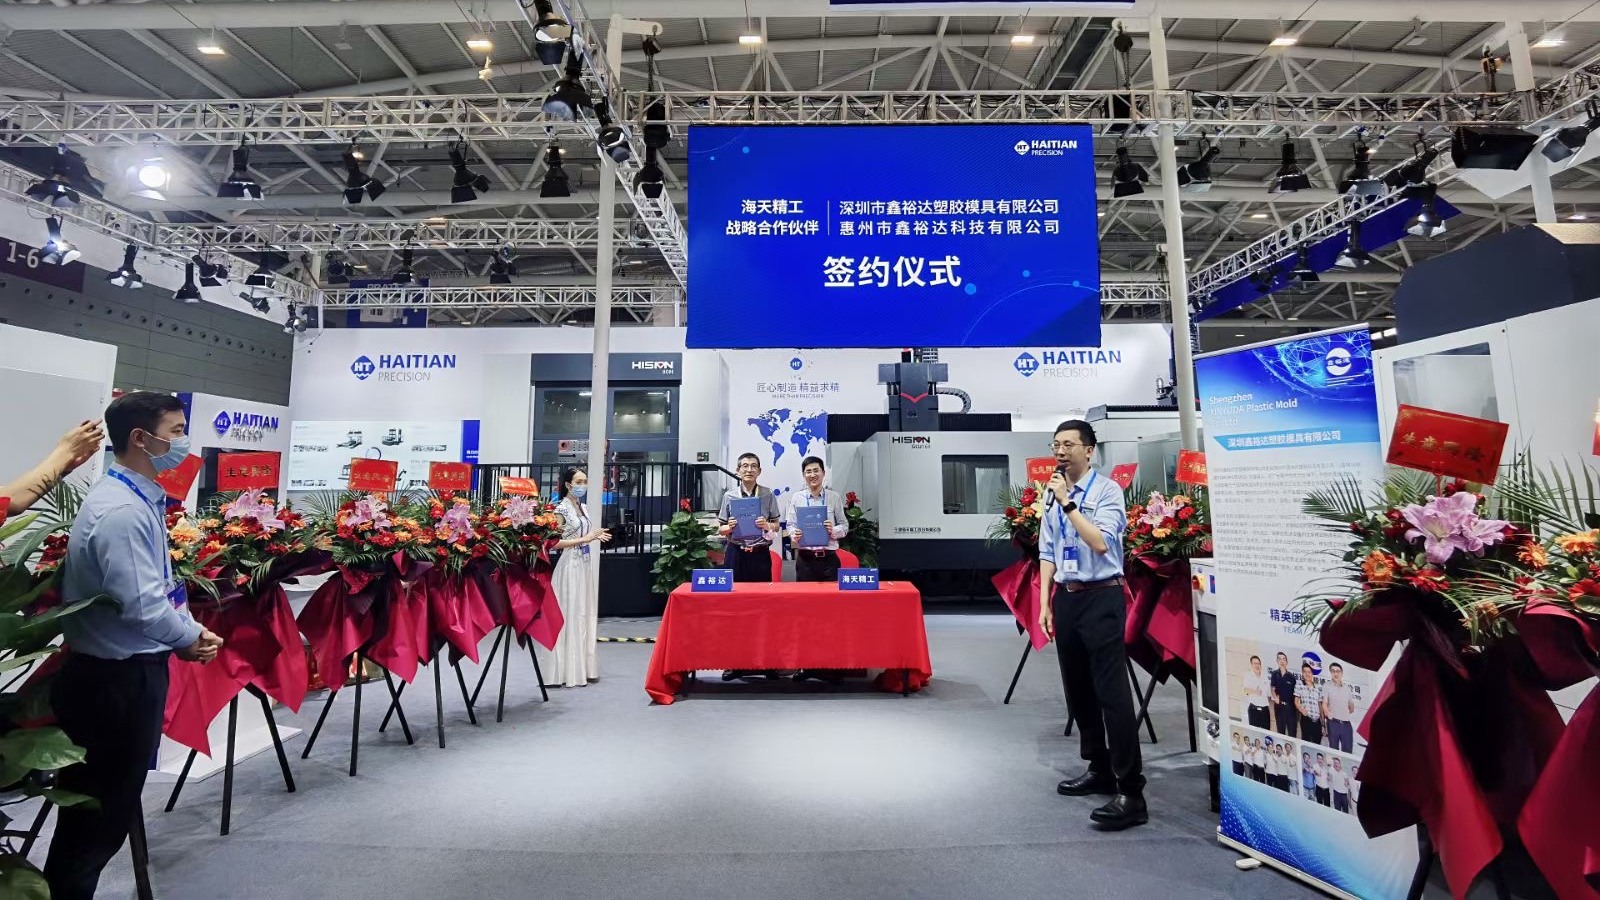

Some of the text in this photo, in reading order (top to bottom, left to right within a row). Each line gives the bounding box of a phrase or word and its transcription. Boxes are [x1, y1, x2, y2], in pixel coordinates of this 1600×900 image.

[1031, 140, 1077, 149] HAITIAN
[741, 199, 804, 214] 海天精工
[839, 200, 1059, 216] 深圳市鑫裕达塑胶模具有限公司
[725, 220, 819, 236] 战略合作伙伴
[839, 220, 1060, 236] 惠州市鑫裕达科技有限公司
[7, 242, 40, 269] 1-6
[823, 255, 962, 288] 签约仪式
[379, 354, 456, 369] HAITIAN
[1042, 350, 1121, 365] HAITIAN
[378, 371, 431, 382] PRECISION
[1043, 367, 1098, 378] PRECISION
[757, 382, 840, 393] 匠心制造 精益求精
[1208, 393, 1253, 406] Shengzhen
[1246, 400, 1274, 413] Plastic
[1275, 398, 1298, 409] Mold
[233, 411, 279, 429] HAITIAN
[697, 576, 727, 585] 鑫裕达
[842, 575, 875, 584] 海天精工
[1269, 608, 1314, 625] 精英团
